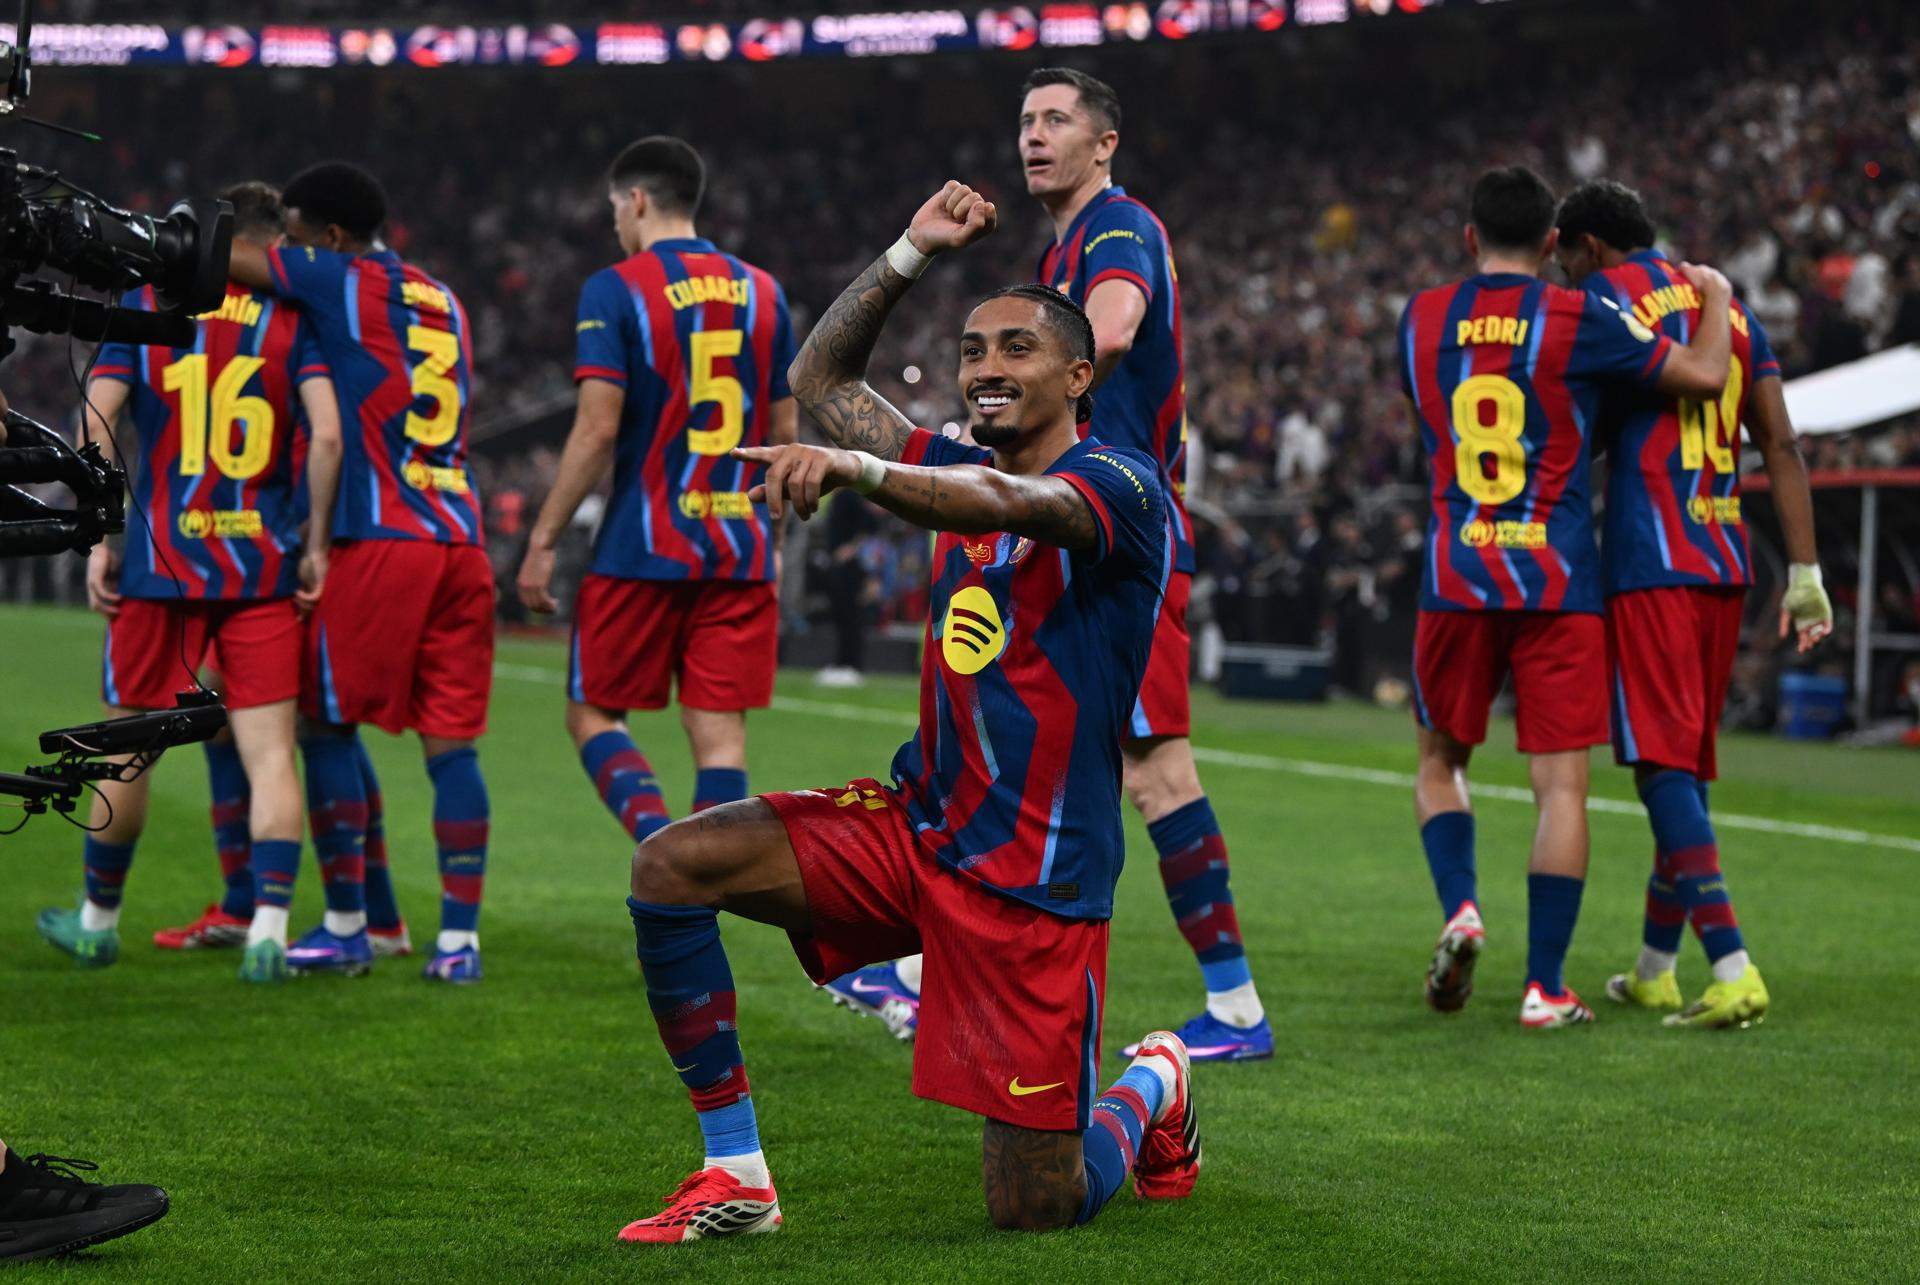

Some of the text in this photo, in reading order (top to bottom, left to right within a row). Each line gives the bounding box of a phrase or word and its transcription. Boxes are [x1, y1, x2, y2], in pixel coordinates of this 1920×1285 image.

[403, 325, 461, 448] 3
[686, 329, 744, 457] 5
[1457, 316, 1529, 347] PEDRI
[162, 353, 276, 480] 16
[1450, 373, 1527, 505] 8
